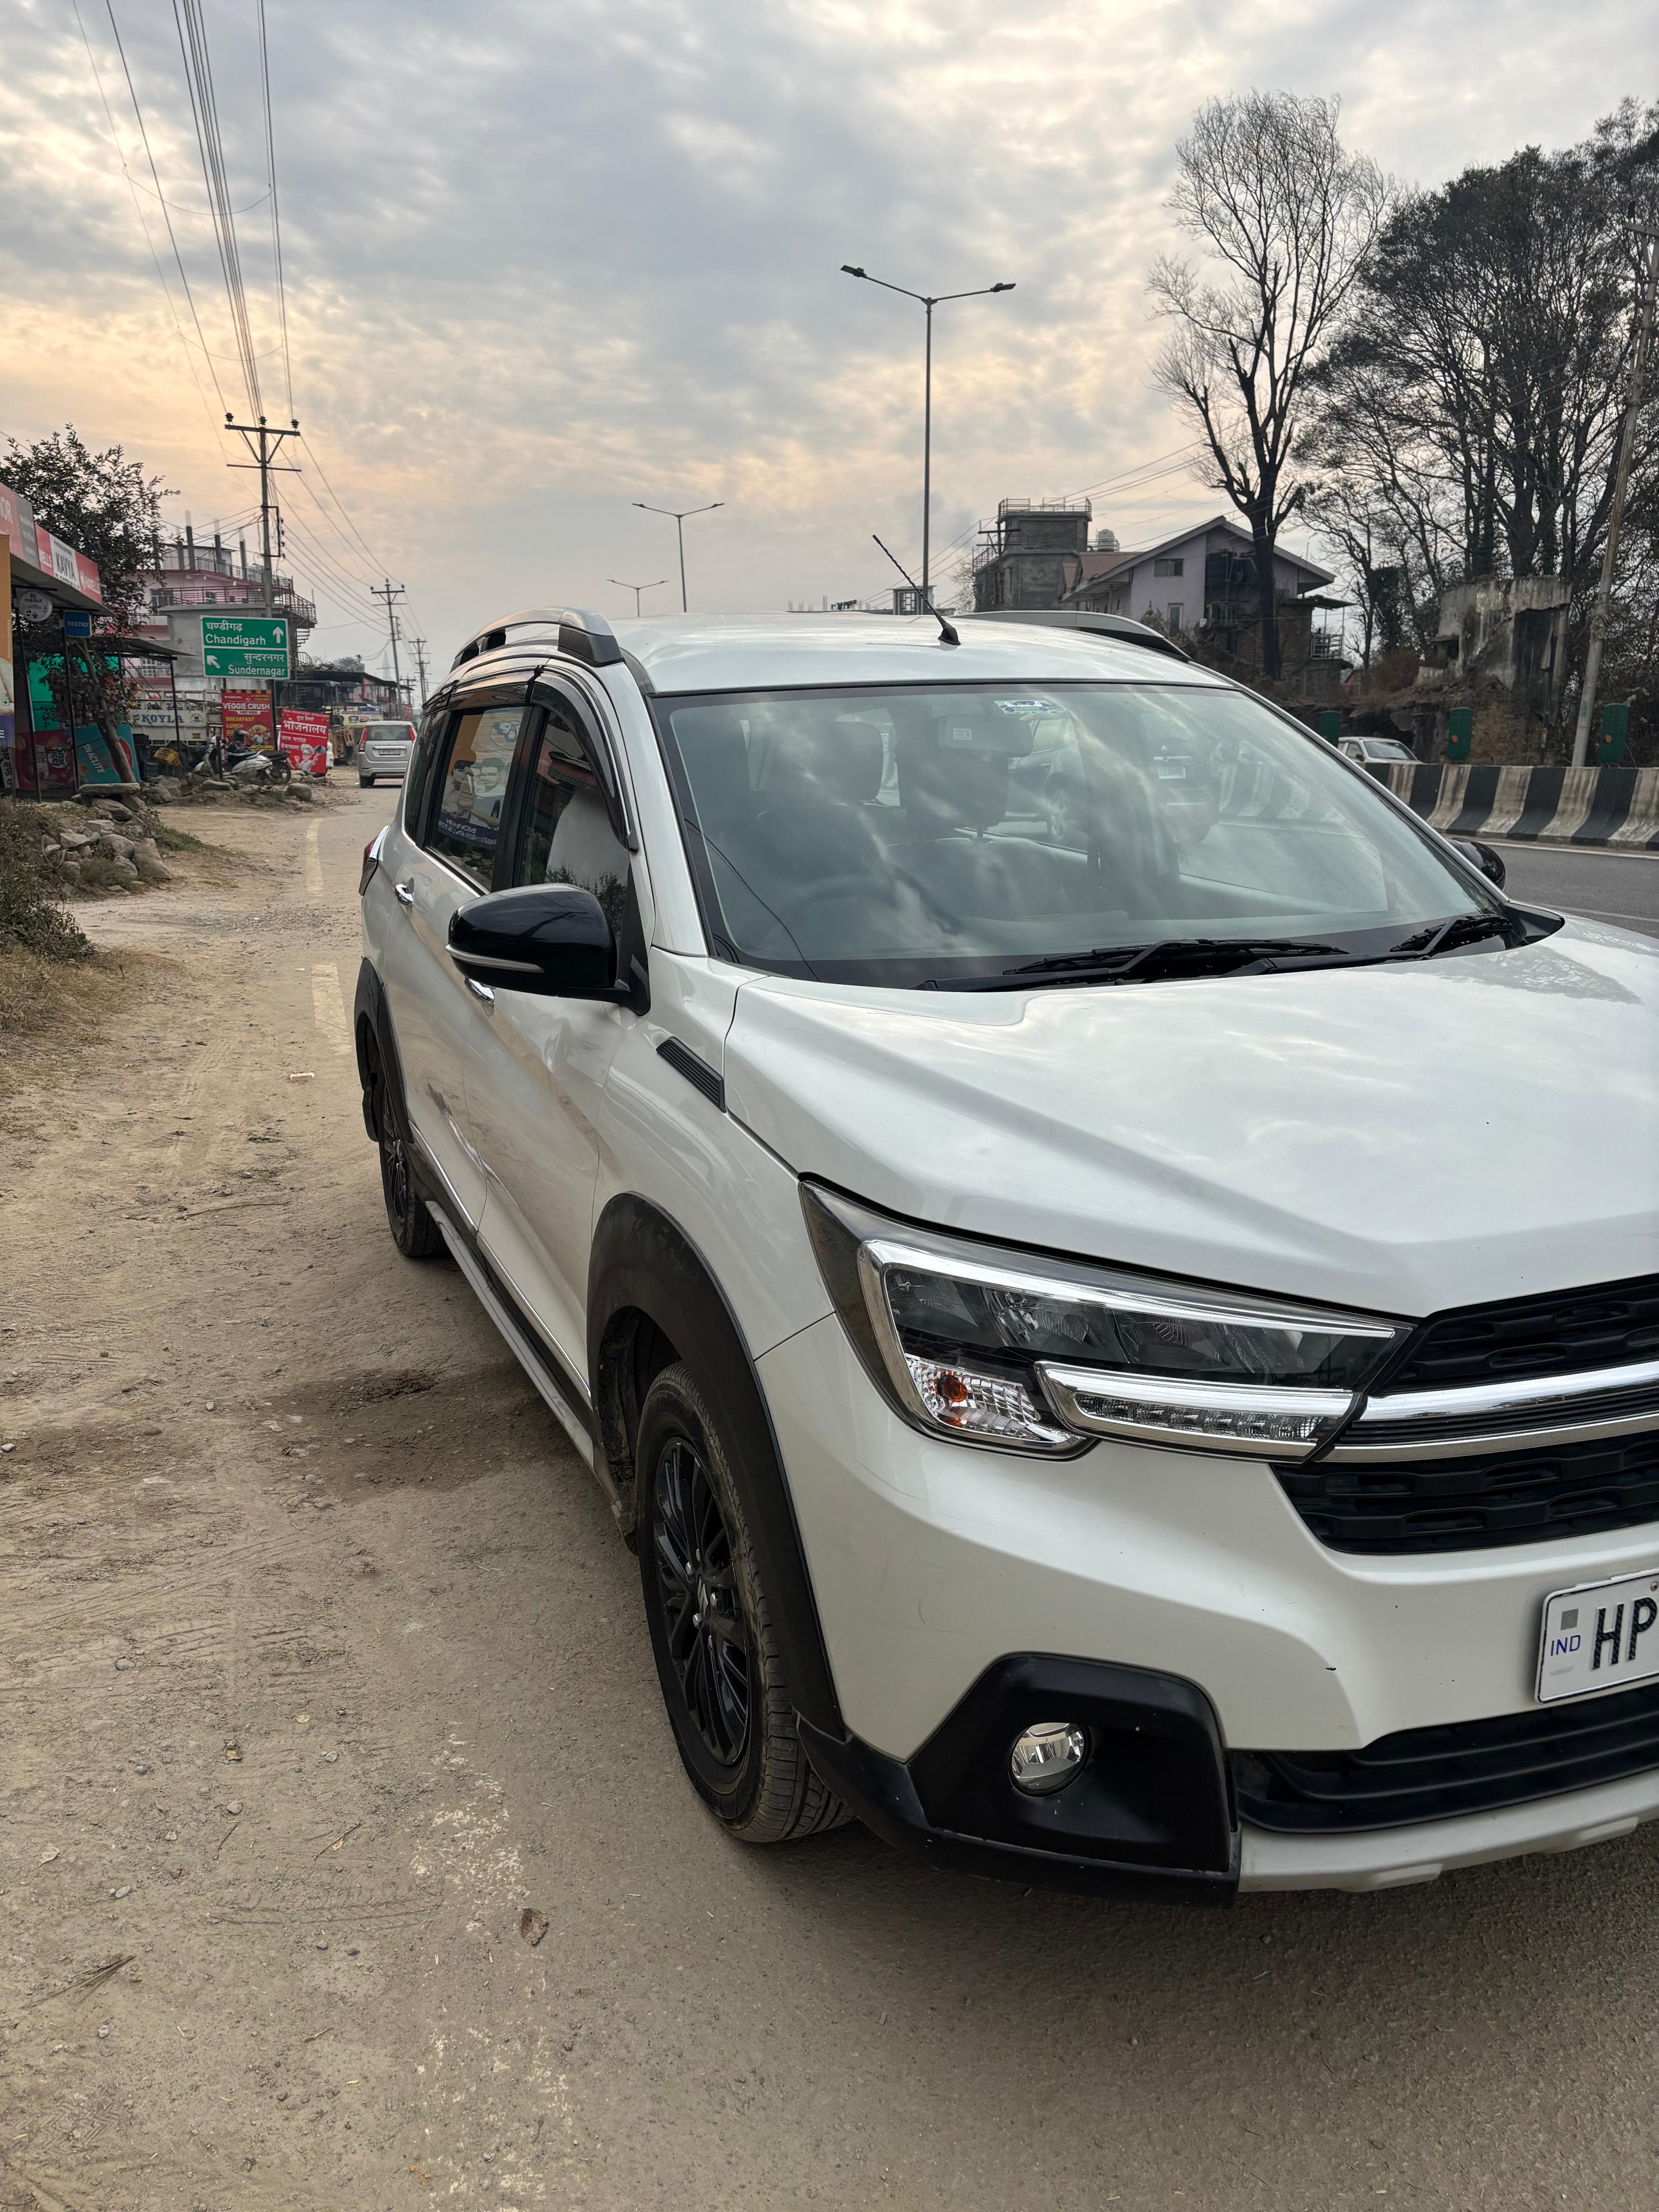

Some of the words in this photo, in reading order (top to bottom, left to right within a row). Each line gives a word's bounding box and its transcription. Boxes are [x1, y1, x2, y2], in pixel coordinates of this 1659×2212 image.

[55, 551, 76, 582] KAVYA
[205, 619, 243, 632] चण्डीगढ़
[205, 633, 266, 646] Chandigarh
[244, 653, 284, 665] सुन्दरनगर
[228, 664, 286, 677] Sundernagar
[141, 714, 184, 724] KOYLA
[283, 718, 327, 734] भोजनालय
[82, 743, 105, 774] SNACLITE
[1592, 1597, 1657, 1670] HP
[1550, 1634, 1581, 1656] IND
